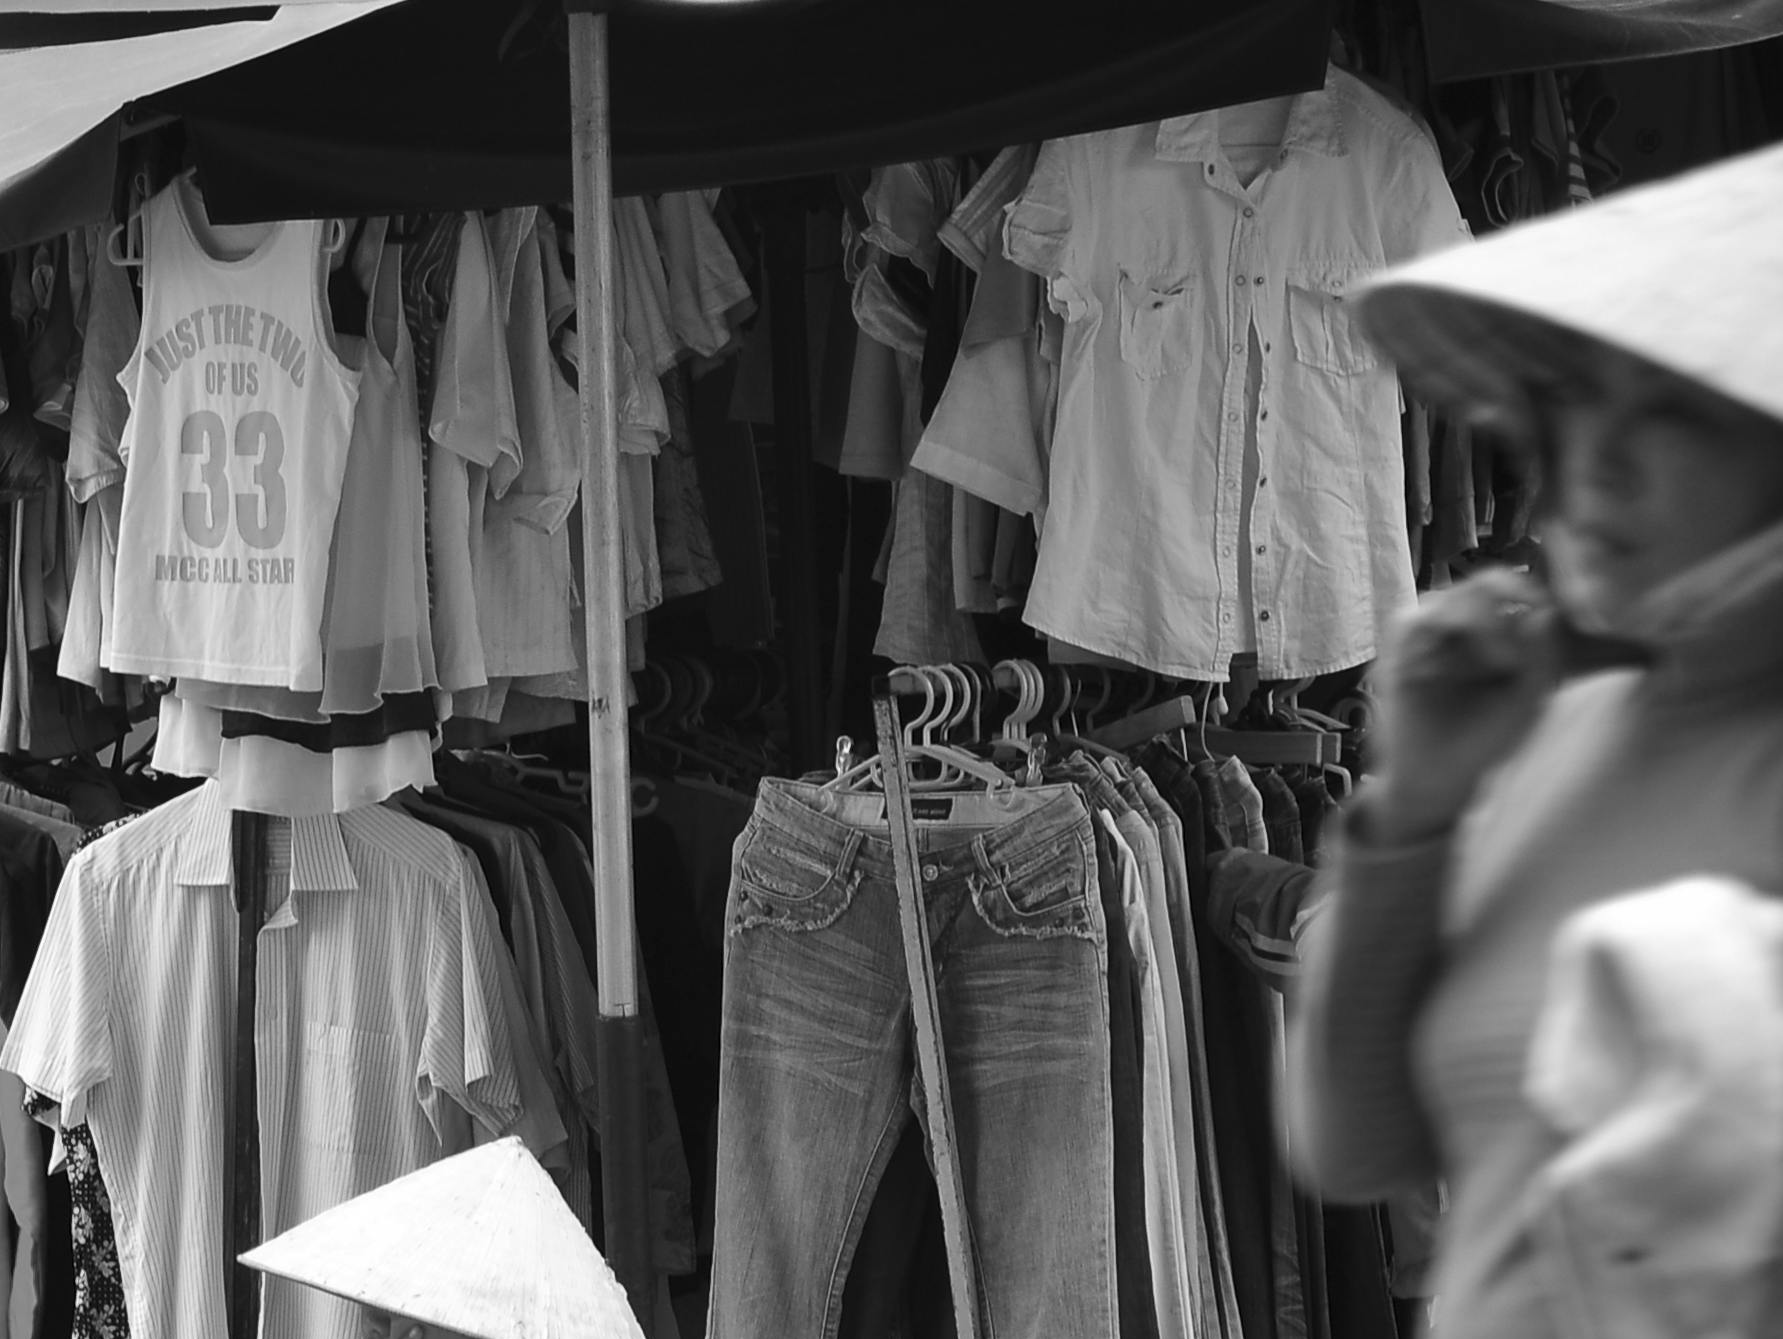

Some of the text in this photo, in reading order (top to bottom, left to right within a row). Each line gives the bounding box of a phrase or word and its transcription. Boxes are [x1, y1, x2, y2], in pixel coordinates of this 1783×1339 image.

[144, 308, 205, 385] JUST
[208, 304, 255, 347] THE
[205, 361, 258, 397] OF US
[181, 410, 287, 550] 33
[155, 555, 295, 584] MCC ALL STAR
